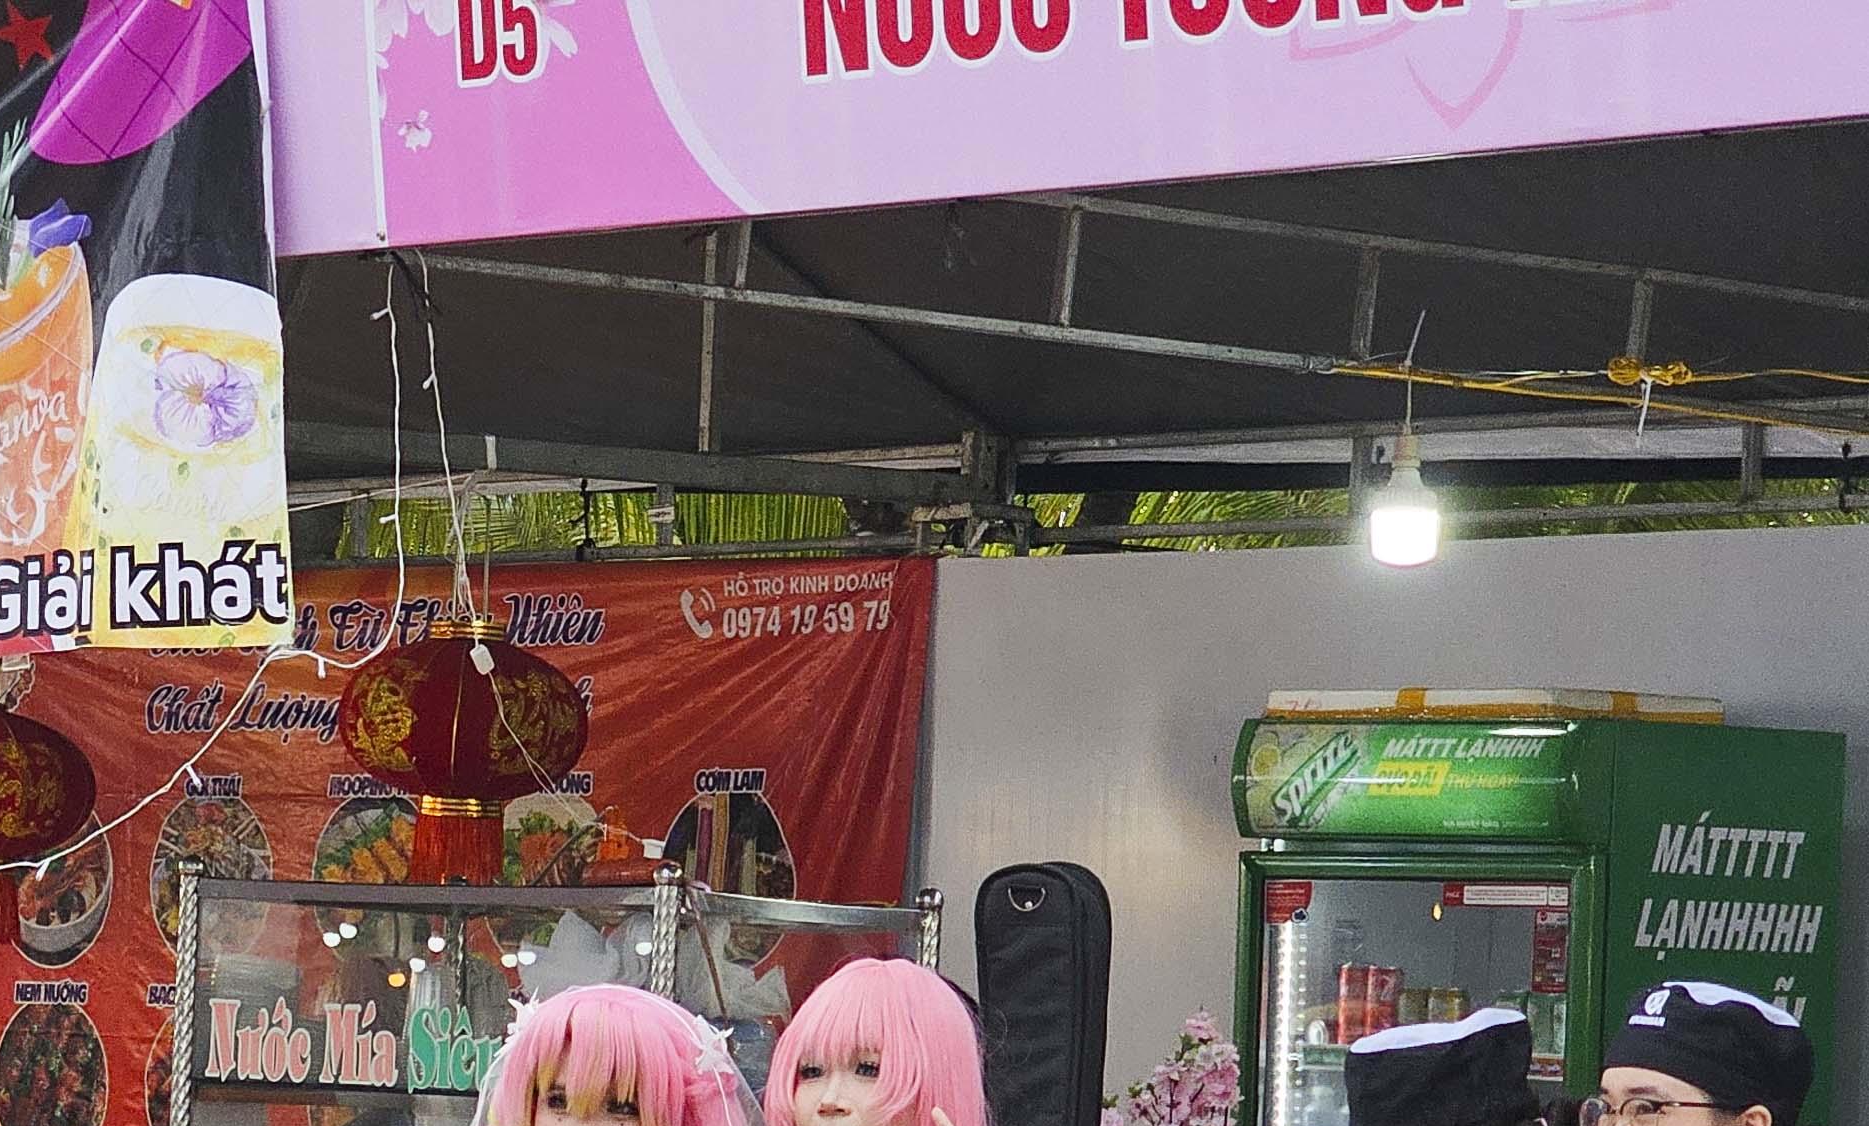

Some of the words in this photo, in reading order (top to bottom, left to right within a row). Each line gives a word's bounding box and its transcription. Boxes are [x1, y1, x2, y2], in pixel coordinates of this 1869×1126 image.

[108, 539, 292, 630] khát
[789, 575, 829, 594] KINH
[834, 571, 894, 593] DOANH
[503, 592, 606, 649] Nhiên
[722, 605, 782, 639] 0974
[789, 603, 819, 636] 19
[823, 600, 855, 634] 59
[863, 598, 891, 632] 79
[145, 679, 226, 734] Chất
[229, 684, 343, 744] Lượng
[732, 769, 765, 793] LAM
[1652, 811, 1806, 879] MÁTTTTT
[1635, 898, 1823, 961] LẠNHHHHH
[14, 982, 42, 1003] NEM
[204, 996, 312, 1084] Nước
[318, 1000, 398, 1087] Mía
